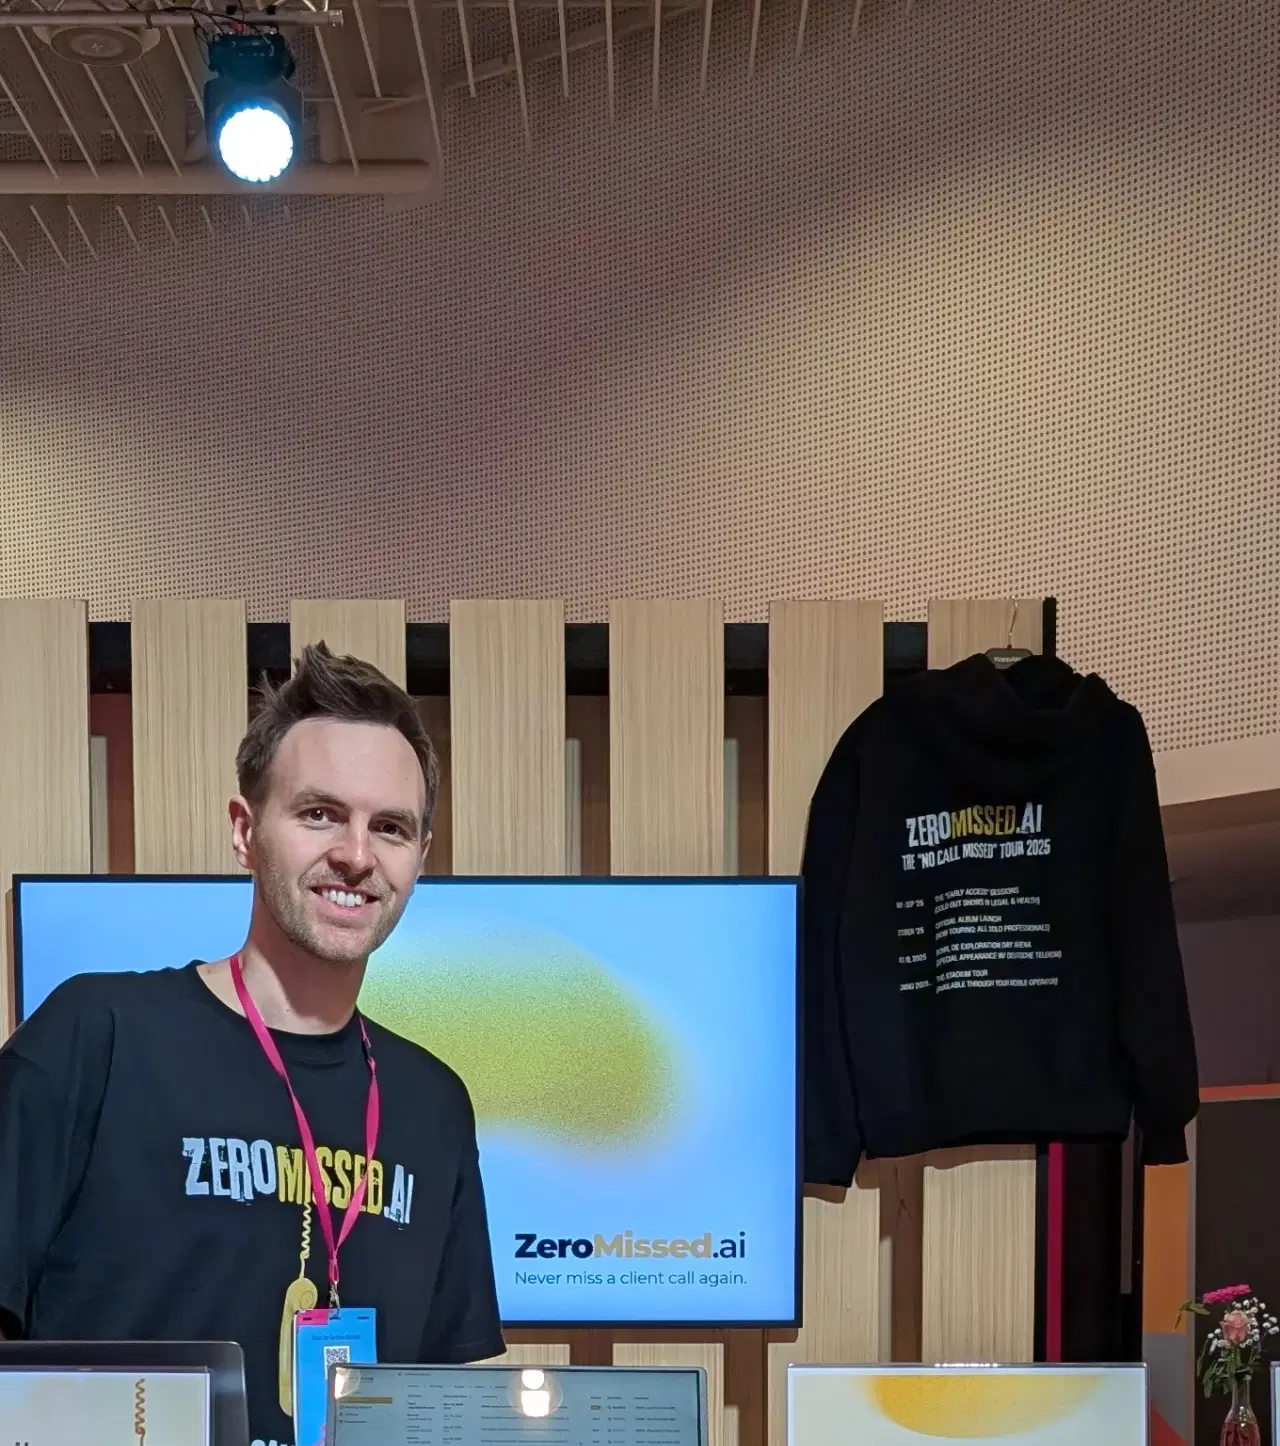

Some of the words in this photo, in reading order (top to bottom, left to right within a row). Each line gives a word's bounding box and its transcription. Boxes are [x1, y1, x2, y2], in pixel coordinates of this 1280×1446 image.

[905, 801, 1043, 848] ZEROMISSED.AI
[901, 853, 916, 871] THE
[936, 845, 961, 866] CALL
[999, 840, 1025, 859] TOUR
[1026, 838, 1051, 857] 2025
[972, 968, 989, 977] TOUR
[515, 1230, 746, 1259] ZeroMissed.ai
[515, 1272, 562, 1285] Never
[567, 1271, 603, 1285] miss
[606, 1275, 616, 1285] a
[620, 1271, 664, 1285] client
[669, 1271, 695, 1285] call
[699, 1272, 747, 1287] again.
